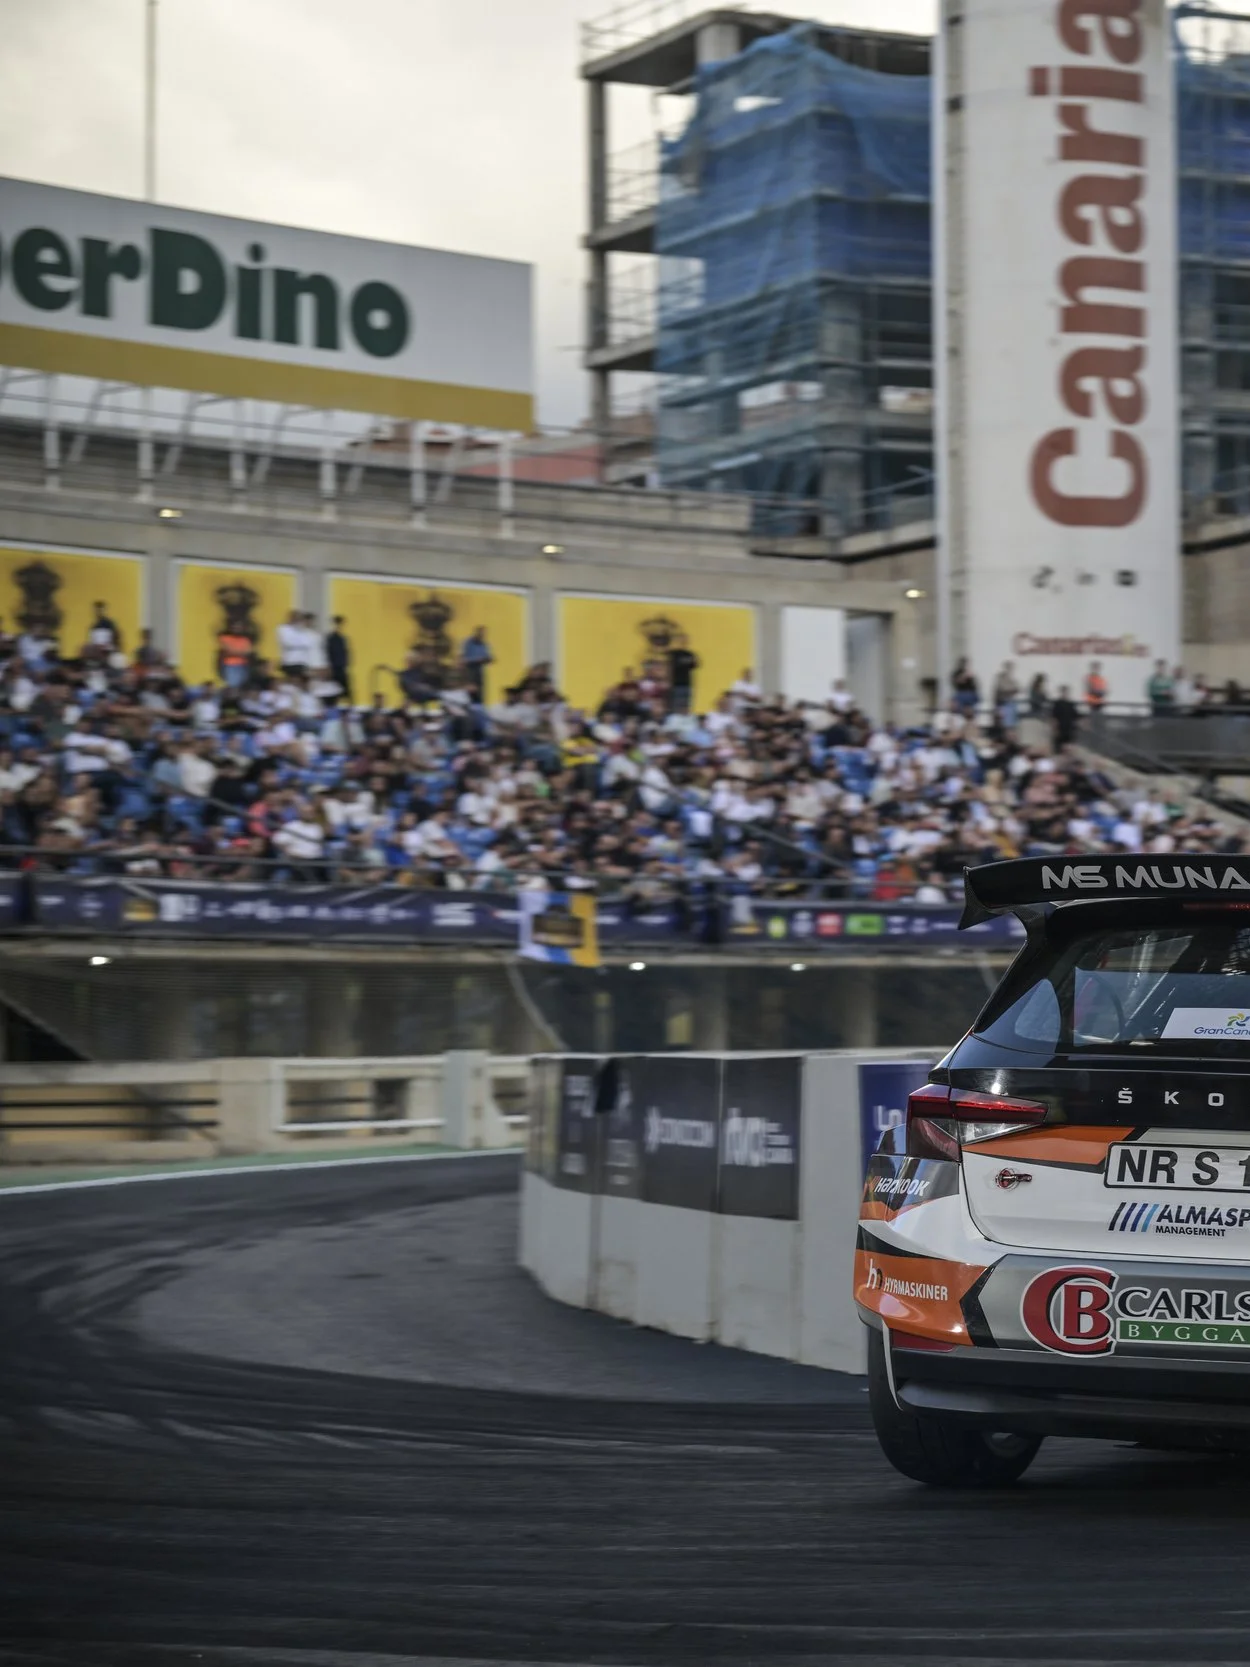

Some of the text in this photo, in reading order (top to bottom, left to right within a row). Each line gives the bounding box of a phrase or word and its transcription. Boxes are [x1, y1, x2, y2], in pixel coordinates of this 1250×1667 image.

[0, 224, 412, 358] erDino
[1041, 865, 1107, 890] MS
[1117, 1148, 1176, 1183] NR
[1192, 1150, 1220, 1186] S
[1155, 1225, 1226, 1237] MANAGEMENT
[883, 1276, 949, 1301] HYRMASKINER
